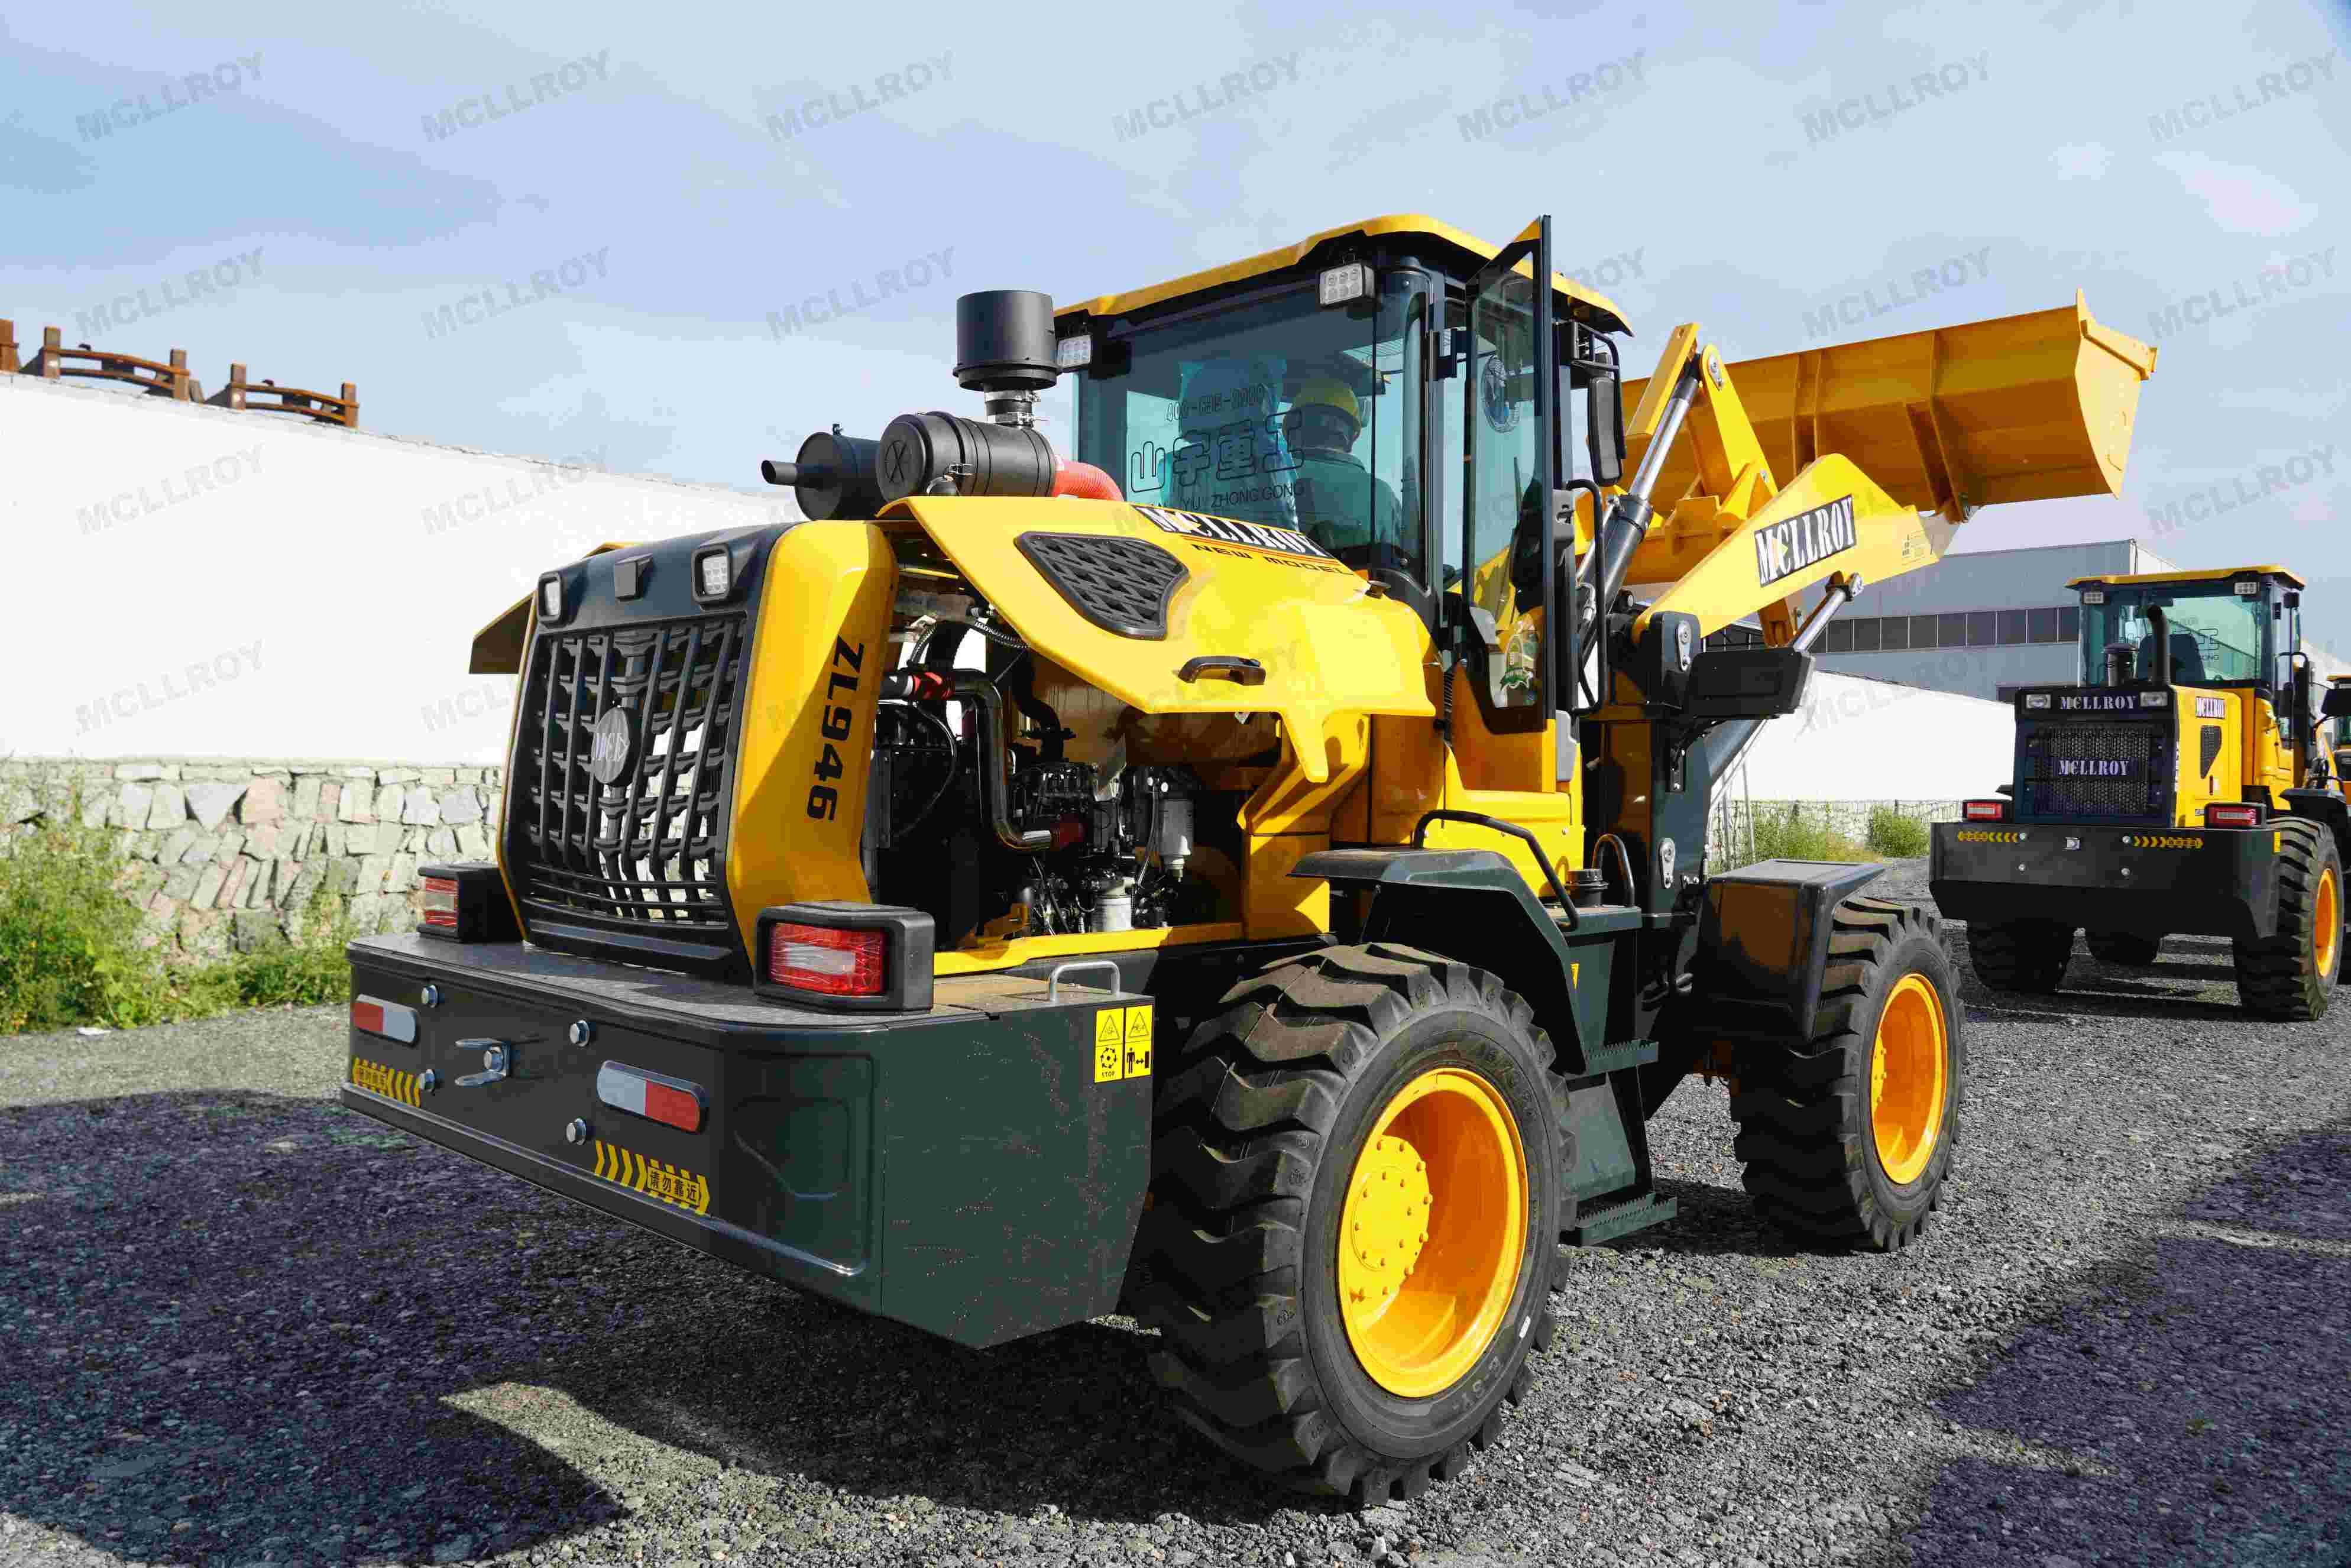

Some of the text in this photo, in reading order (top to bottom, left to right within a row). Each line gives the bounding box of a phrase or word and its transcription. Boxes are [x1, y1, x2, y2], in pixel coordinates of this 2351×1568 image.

[1210, 487, 1258, 509] ZHONG
[1261, 478, 1306, 501] GONG
[1134, 506, 1330, 558] MCLLROY
[1755, 495, 1855, 584] MCLLROY
[1191, 543, 1354, 575] NEW MODEL
[2060, 695, 2138, 710] MCLLROY
[807, 634, 864, 821] ZL946
[2057, 759, 2129, 776] MCLLROY
[650, 1171, 698, 1203] 请勿靠近
